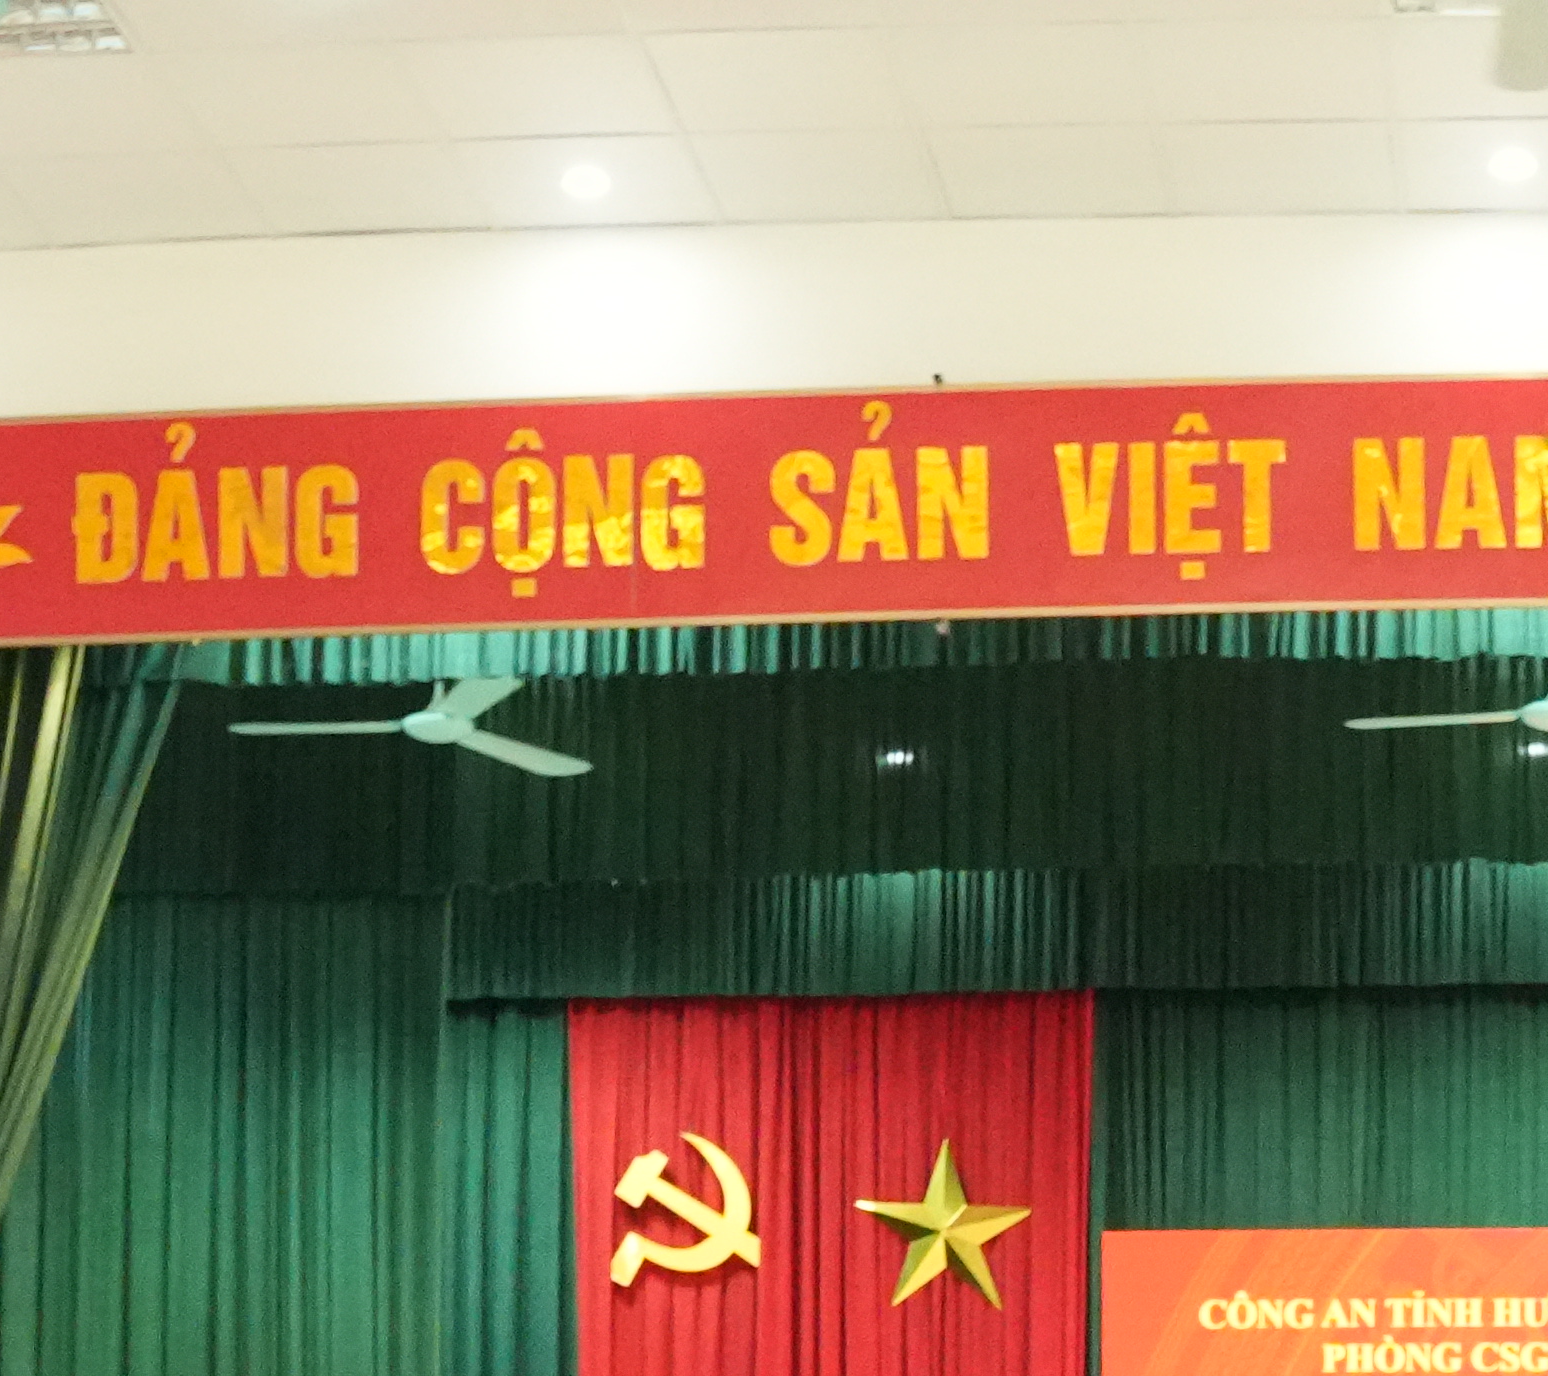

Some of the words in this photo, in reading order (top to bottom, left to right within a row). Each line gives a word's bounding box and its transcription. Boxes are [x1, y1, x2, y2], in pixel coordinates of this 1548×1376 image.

[69, 417, 359, 584] ĐẢNG
[421, 429, 705, 597] CỘNG
[769, 401, 989, 566] SẢN
[1054, 413, 1286, 580] VIỆT
[1199, 1290, 1314, 1329] CÔNG
[1321, 1299, 1375, 1328] AN
[1385, 1291, 1482, 1327] TỈNH
[1324, 1335, 1462, 1372] PHÒNG
